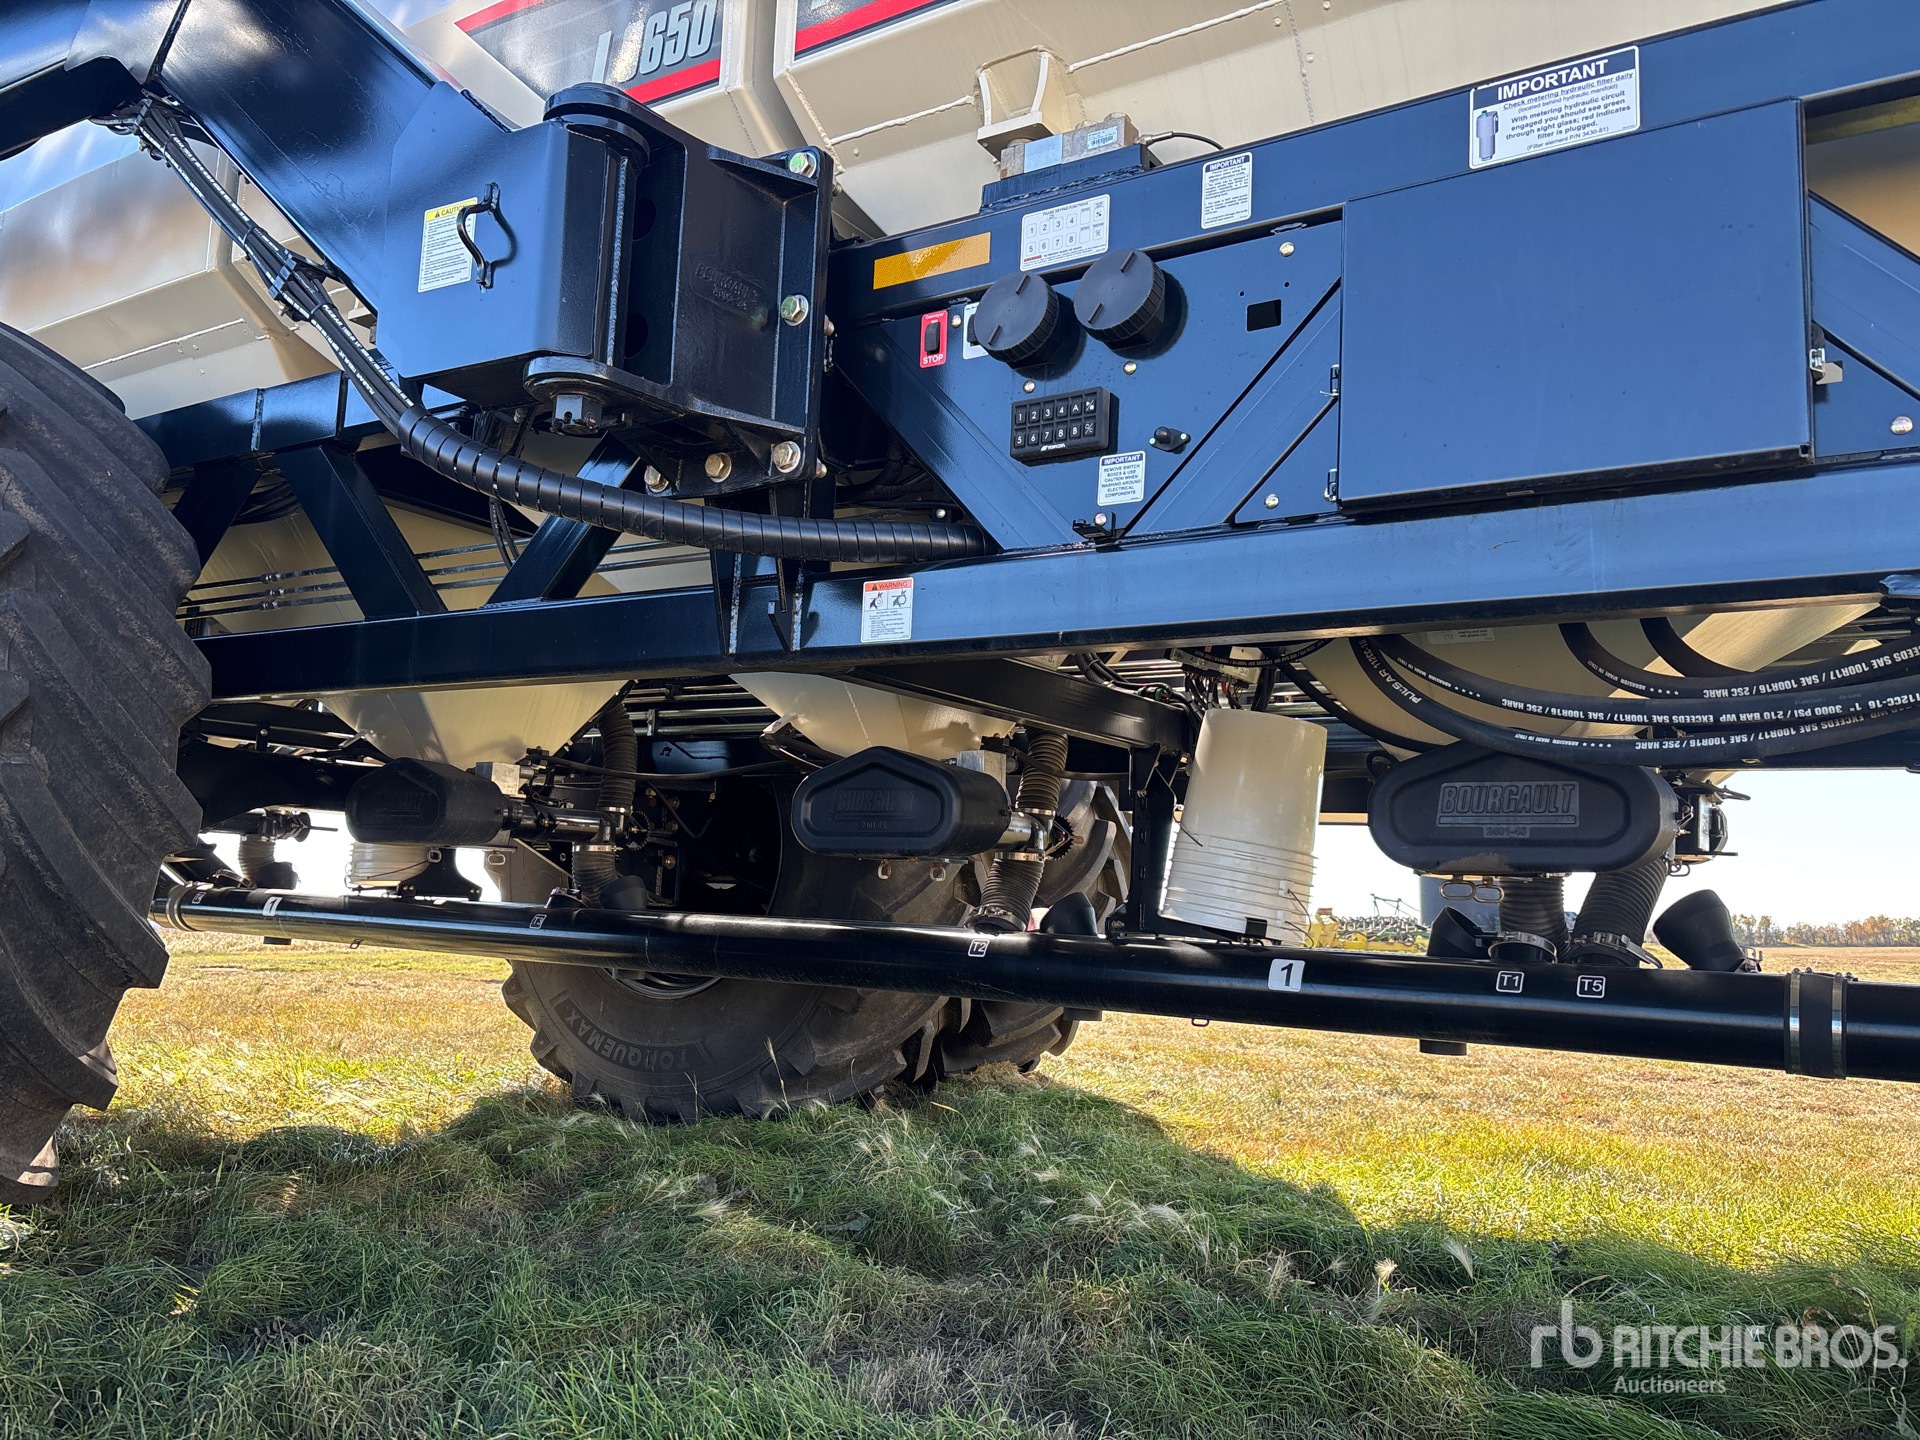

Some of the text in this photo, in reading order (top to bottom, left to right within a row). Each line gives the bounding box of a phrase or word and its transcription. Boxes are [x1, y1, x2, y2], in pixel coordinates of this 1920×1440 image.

[1497, 59, 1609, 101] IMPORTANT
[1503, 72, 1634, 111] Check metering hydraulic filter daily
[1518, 83, 1618, 114] (located behind hydraulic manifold)
[1511, 90, 1626, 124] With metering hydraulic circuit
[1511, 99, 1626, 132] engaged you should see green
[1506, 105, 1631, 140] through sight glass; red indicates
[1537, 131, 1555, 140] filter
[1564, 121, 1598, 135] plugged.
[1544, 136, 1568, 146] element
[1569, 132, 1581, 141] P/N
[1209, 156, 1246, 171] IMPORTANT
[441, 203, 467, 216] CAUTIO
[922, 353, 944, 365] STOP
[1031, 411, 1037, 419] 2
[1045, 408, 1051, 417] 3
[1059, 406, 1064, 414] 4
[1072, 404, 1079, 412] A
[1017, 426, 1078, 444] 5 6 7 8 B
[1104, 454, 1141, 465] IMPORTANT
[1105, 489, 1136, 498] COMPONENTS
[1107, 485, 1134, 493] ELECTRICAL
[879, 580, 908, 590] WARNING
[1870, 655, 1892, 669] SAE
[1830, 662, 1870, 681] 100R17
[1378, 668, 1422, 704] PULSAR
[1759, 679, 1798, 694] 100R16
[1799, 674, 1820, 687] SAE
[1703, 688, 1729, 698] HARC
[1731, 686, 1751, 697] 2SC
[1501, 698, 1524, 710] HARC
[1867, 692, 1920, 709] 112CC-16
[1526, 703, 1542, 713] 2SC
[1551, 707, 1585, 719] 100R16
[1794, 707, 1812, 718] PSI
[1814, 704, 1843, 716] 3000
[1587, 711, 1604, 721] SAE
[1613, 713, 1649, 723] 100R17
[1652, 714, 1670, 723] SAE
[1672, 714, 1714, 724] EXCEEDS
[1719, 713, 1738, 723] WP
[1739, 712, 1761, 722] BAR
[1763, 710, 1784, 721] 210
[1821, 713, 1865, 729] EXCEEDS
[1758, 726, 1797, 740] 100R17
[1799, 722, 1819, 734] SAE
[1662, 740, 1680, 749] 2SC
[1689, 737, 1727, 747] 100R16
[1729, 734, 1748, 744] SAE
[1635, 741, 1660, 750] HARC
[1440, 783, 1576, 815] BOURGAULT
[972, 941, 987, 952] T2
[1279, 962, 1295, 988] 1
[1500, 973, 1520, 988] T1
[1580, 979, 1603, 993] T5
[565, 1008, 690, 1071] TORQUEMAX
